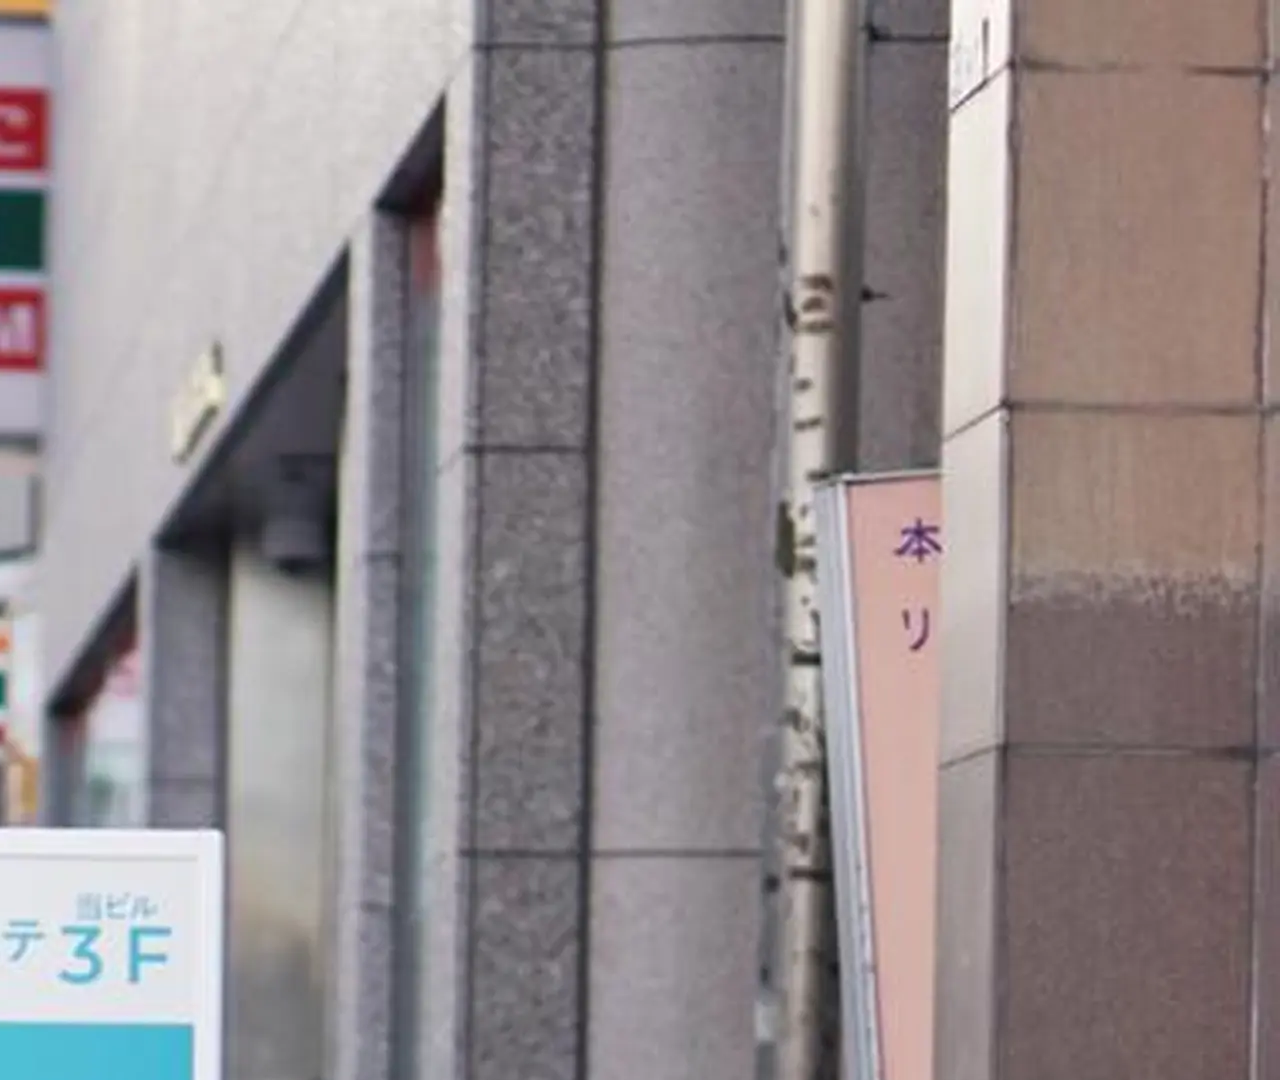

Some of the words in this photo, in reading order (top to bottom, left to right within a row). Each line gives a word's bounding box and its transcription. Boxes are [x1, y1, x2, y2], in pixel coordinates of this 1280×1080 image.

[894, 518, 942, 563] 本
[901, 608, 930, 652] リ
[77, 892, 158, 921] 当ビル
